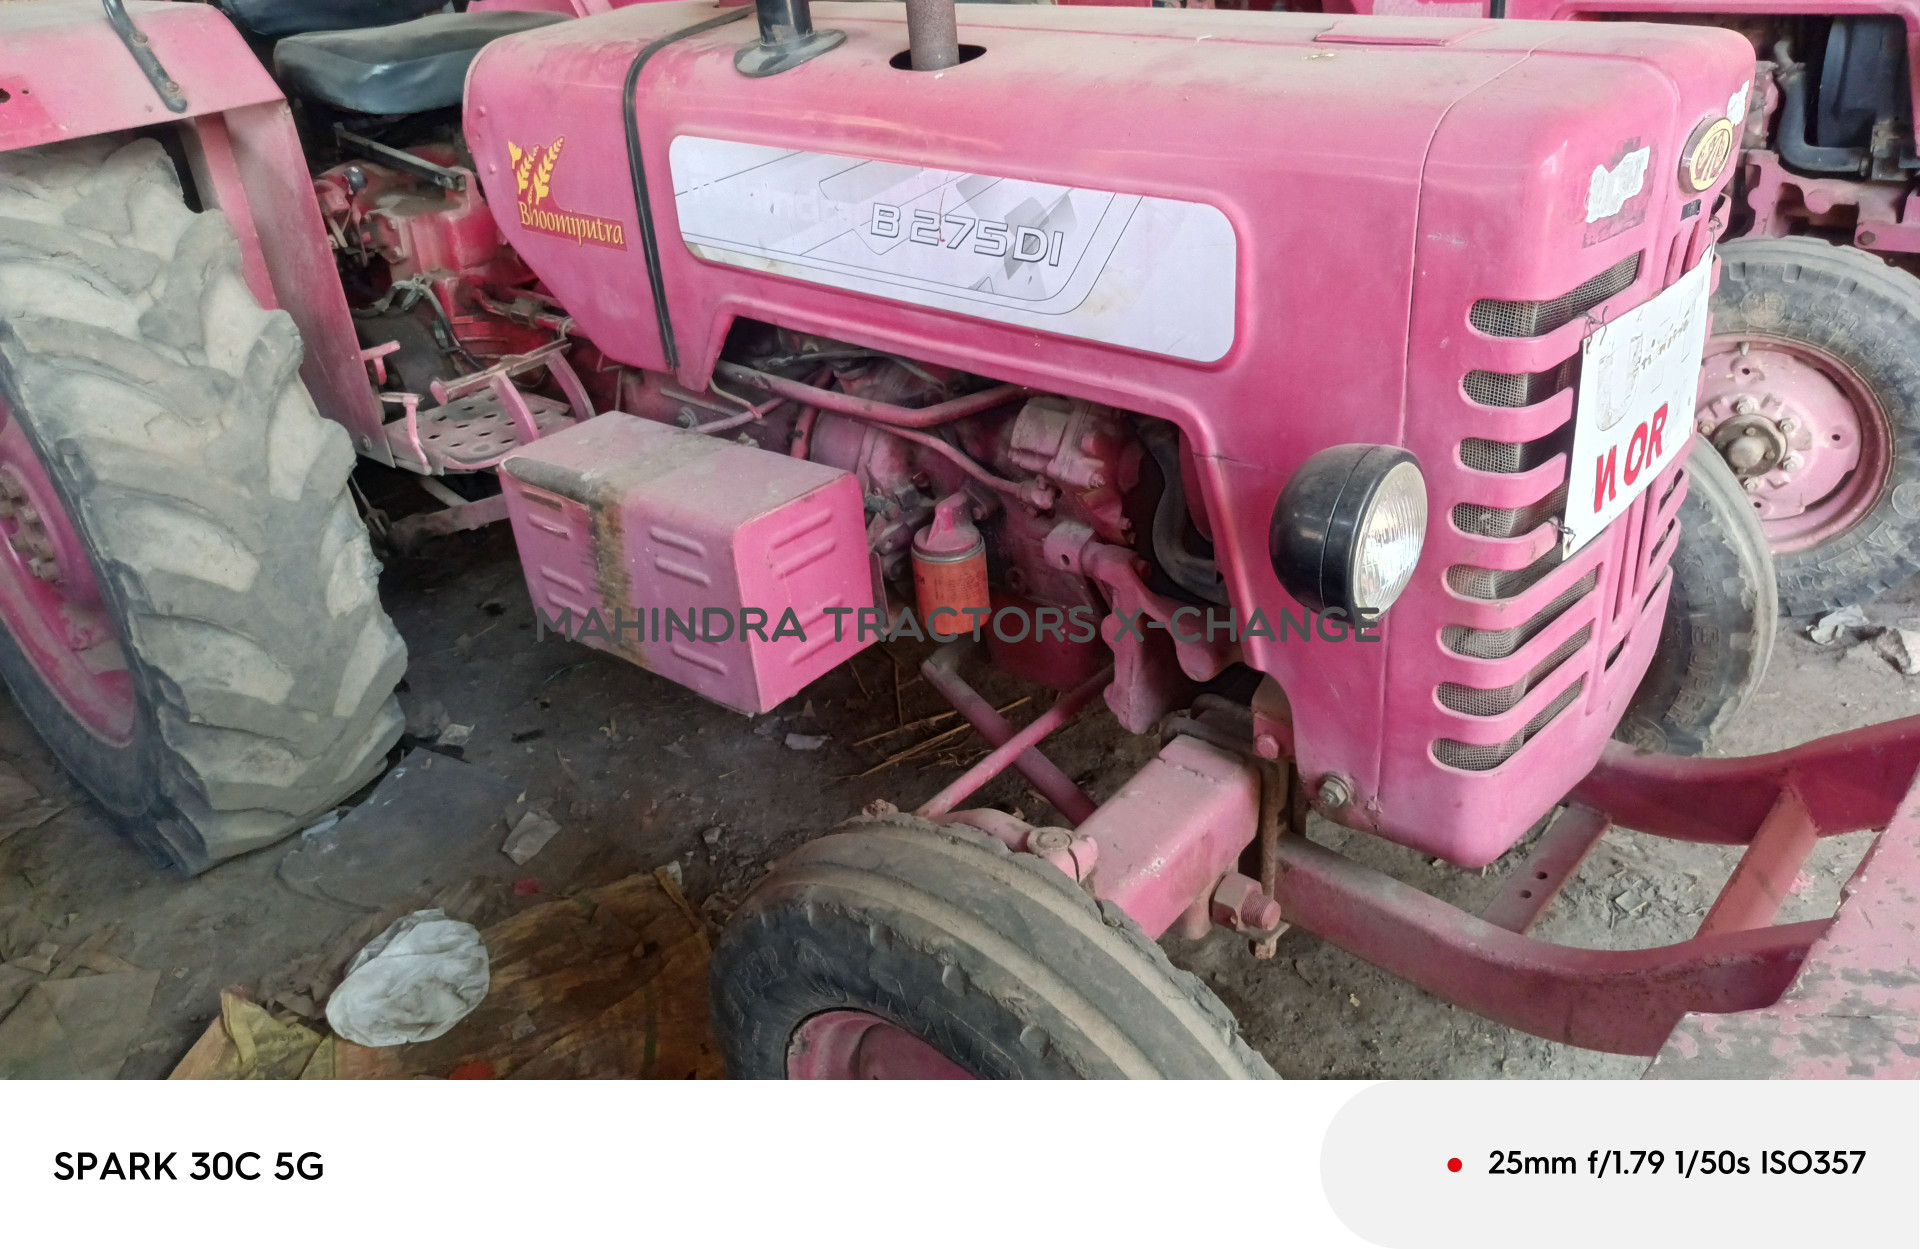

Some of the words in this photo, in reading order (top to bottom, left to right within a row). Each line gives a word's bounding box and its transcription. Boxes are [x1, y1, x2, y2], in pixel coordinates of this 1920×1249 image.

[517, 201, 625, 247] Bhoomiputra
[870, 202, 901, 238] B
[909, 208, 1064, 267] 275DI
